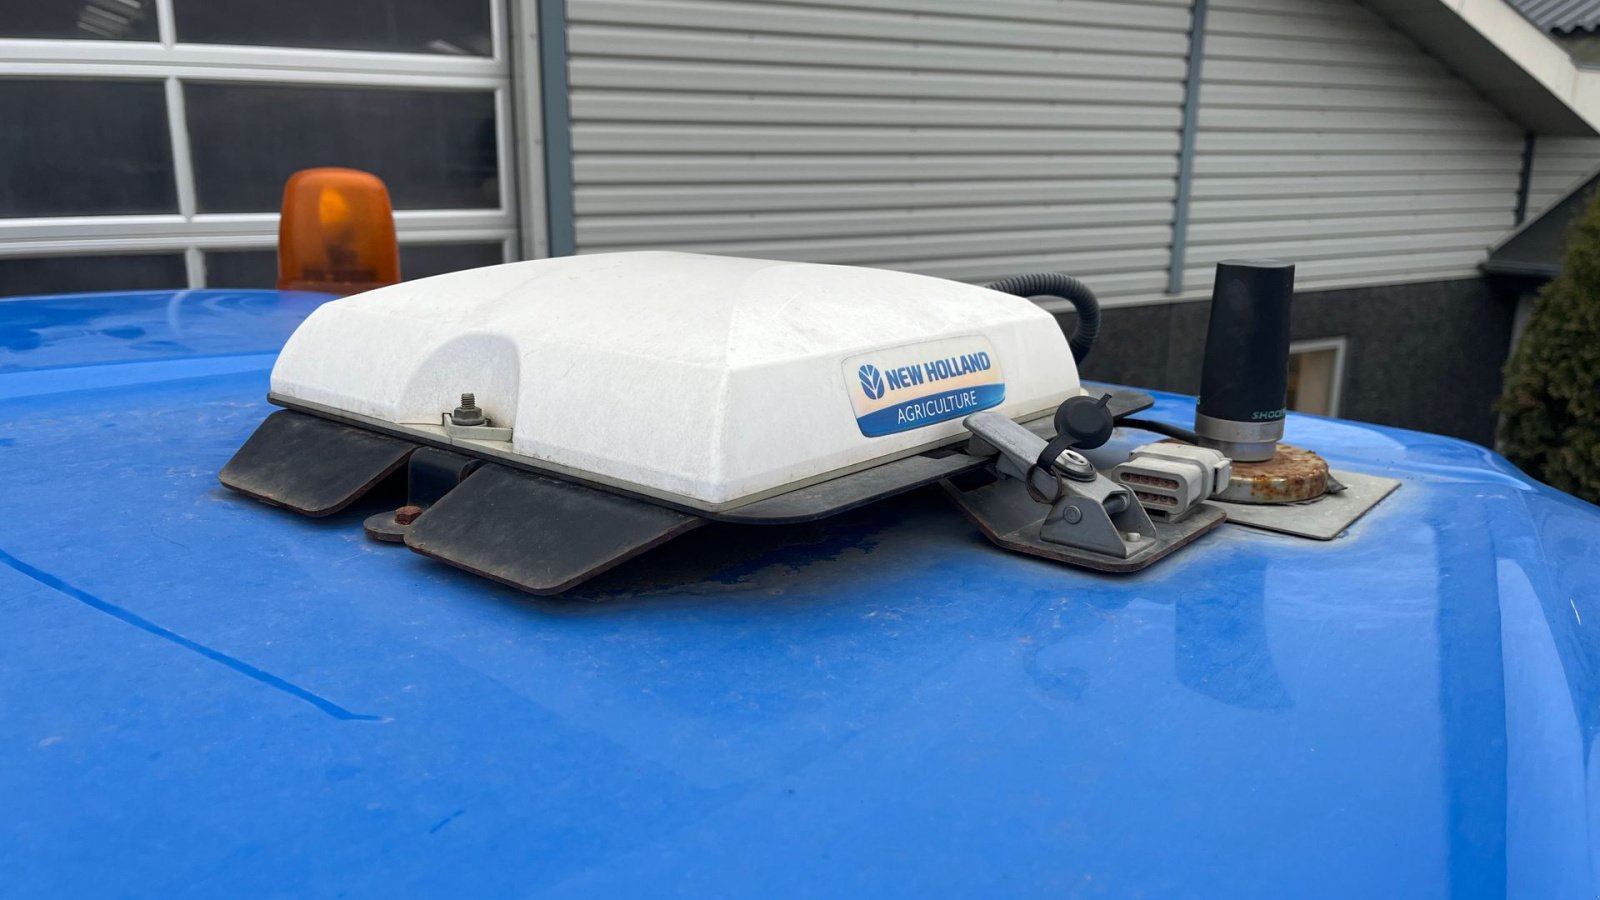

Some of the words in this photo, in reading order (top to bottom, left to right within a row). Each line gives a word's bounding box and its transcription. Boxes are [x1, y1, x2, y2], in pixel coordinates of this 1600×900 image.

[885, 364, 924, 390] NEW
[924, 351, 991, 383] HOLLAND
[898, 390, 978, 425] AGRICULTURE
